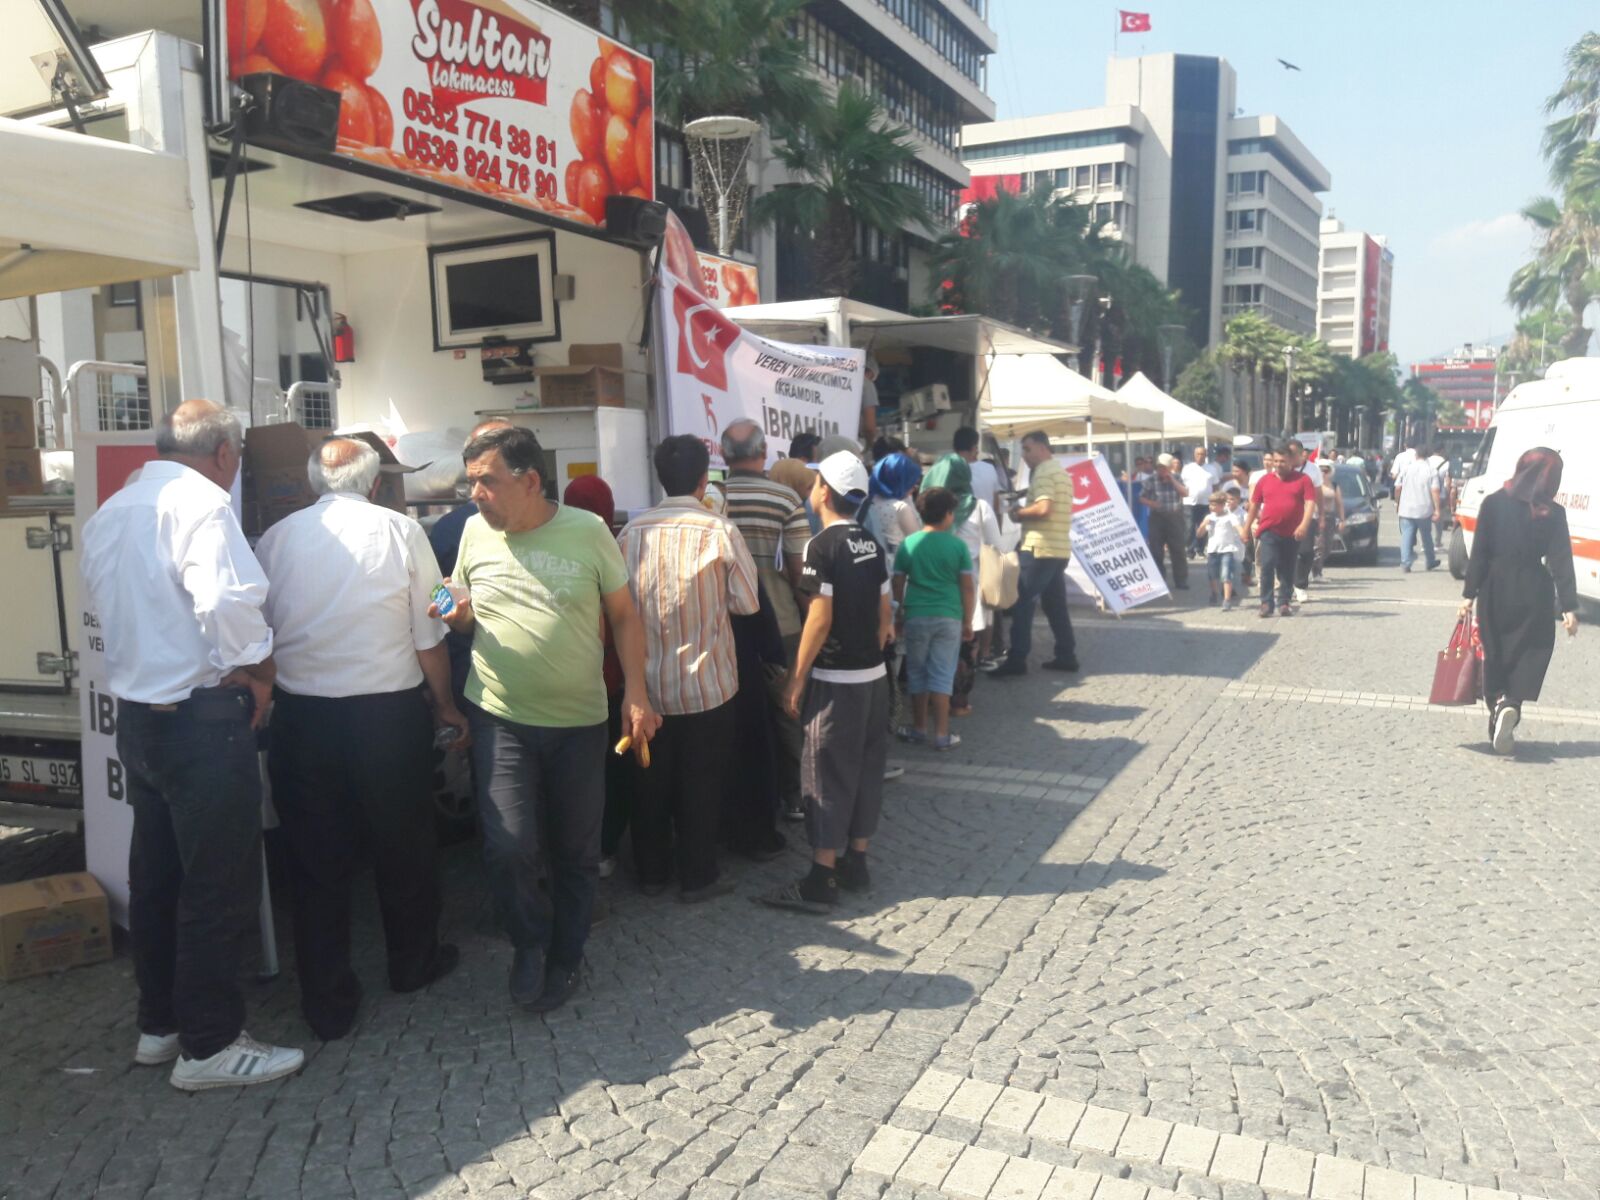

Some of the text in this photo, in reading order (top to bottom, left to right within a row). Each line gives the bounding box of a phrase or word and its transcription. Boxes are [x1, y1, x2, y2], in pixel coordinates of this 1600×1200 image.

[412, 0, 550, 79] Sultan
[403, 87, 557, 168] 0532 774 38 81
[403, 126, 557, 202] 0536 924 76 90
[755, 352, 792, 374] VEREN
[1089, 546, 1148, 577] İBRAHİM
[1107, 565, 1149, 591] BENGİ
[0, 758, 11, 780] 5
[22, 760, 40, 782] SL
